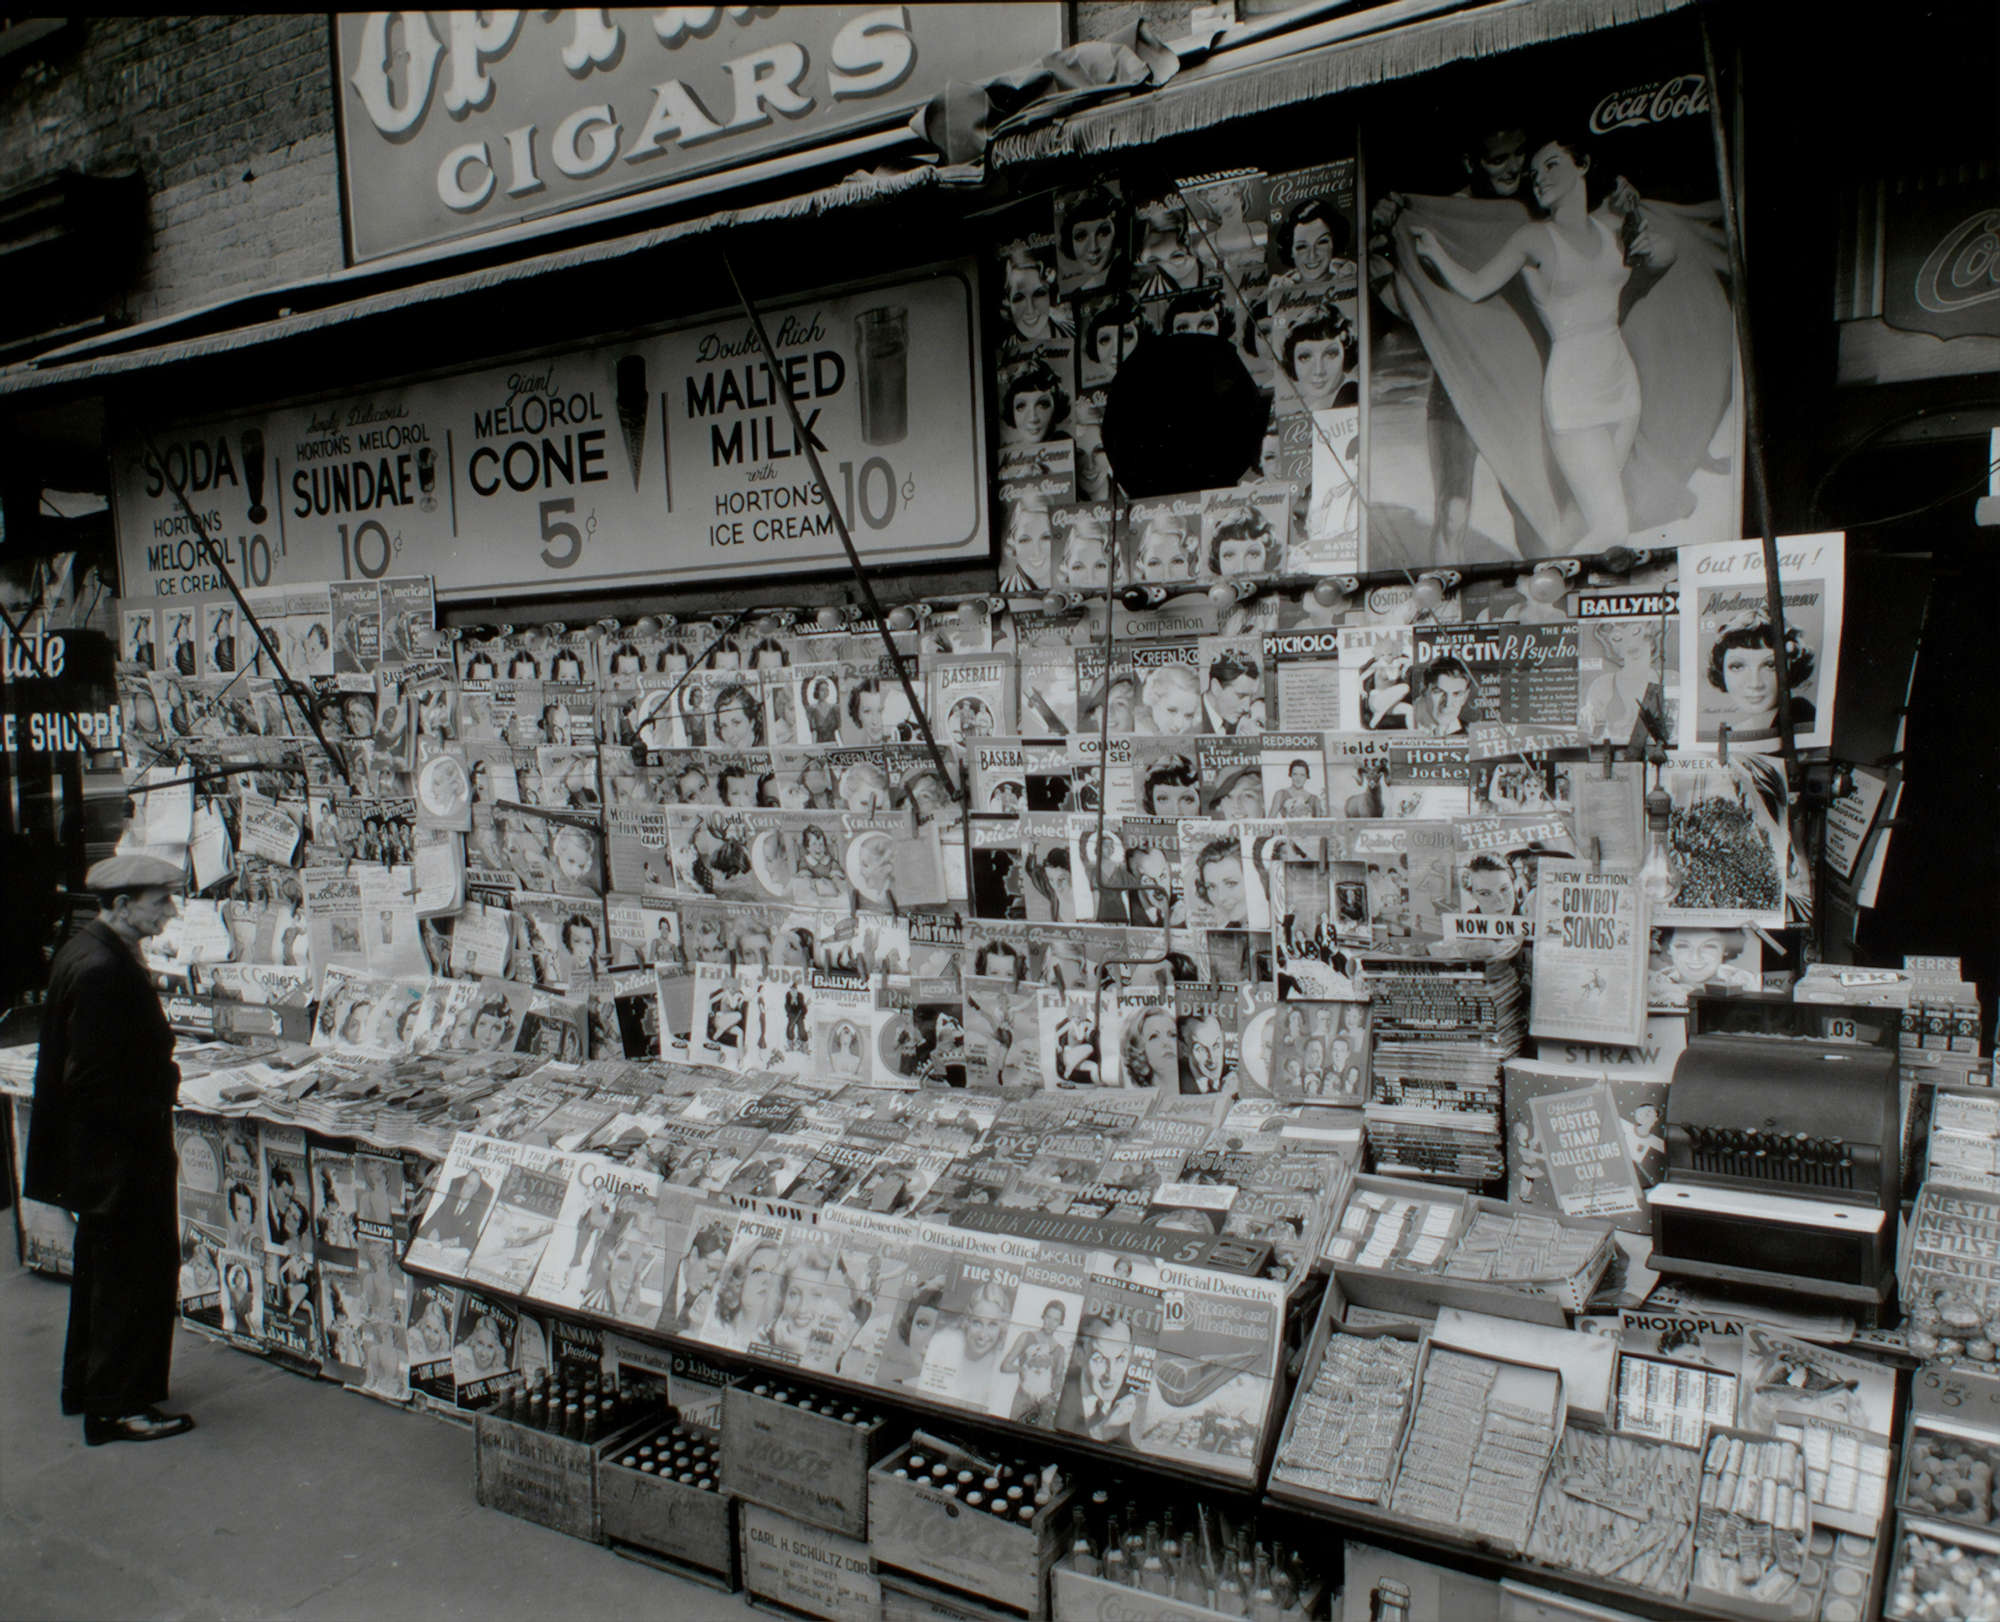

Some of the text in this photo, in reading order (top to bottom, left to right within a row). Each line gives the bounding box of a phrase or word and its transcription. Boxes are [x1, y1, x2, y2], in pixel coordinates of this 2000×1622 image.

[437, 7, 914, 211] CIGARS
[1589, 73, 1710, 135] Coca-Cola
[1175, 166, 1260, 189] BALLYHOO
[777, 312, 826, 348] Rich
[686, 351, 846, 418] MALTED
[474, 392, 603, 438] MELOROL
[296, 422, 431, 461] HORTON'S MELOROL
[711, 409, 829, 466] MILK
[145, 436, 239, 499] SODA
[469, 430, 608, 497] CONE
[745, 463, 778, 482] with
[292, 455, 415, 518] SUNDAE
[715, 479, 826, 516] HORTON'S
[1089, 506, 1124, 524] Stas
[709, 513, 835, 547] ICE CREAM
[147, 537, 236, 572] MELOROL
[1696, 545, 1824, 575] Out Toay!
[156, 579, 176, 596] ICE
[1126, 615, 1204, 636] Companion
[1133, 649, 1177, 666] SCREEN
[942, 665, 1000, 688] BASEBALL
[1262, 735, 1318, 747] REDBOOK
[1455, 815, 1501, 836] NEW
[1461, 821, 1567, 850] THEATRE
[1553, 872, 1629, 885] NEW EDITION
[1562, 886, 1620, 915] COWBOY
[1455, 918, 1516, 936] NOW ON
[1562, 915, 1616, 951] SONGS
[1904, 956, 1960, 970] KERR'S
[1564, 1045, 1662, 1065] STRAW
[1138, 1119, 1205, 1137] RAILROAD
[1550, 1110, 1601, 1133] POSTER
[1559, 1128, 1601, 1149] STAMP
[1551, 1142, 1621, 1168] COLLECTORS
[580, 1161, 650, 1196] Collier's
[1256, 1163, 1326, 1188] SPIDER
[1078, 1182, 1151, 1206] HORROR
[1235, 1197, 1312, 1219] SPIDER
[737, 1219, 784, 1241] PICTURE
[922, 1228, 967, 1250] Official
[1024, 1218, 1108, 1245] PHILLIES
[1110, 1230, 1166, 1253] CIGAR
[1024, 1266, 1083, 1289] REDBOOK
[1159, 1268, 1279, 1302] Official Detective
[1143, 1287, 1159, 1298] THE
[1164, 1303, 1183, 1321] 10
[1623, 1313, 1746, 1338] PHOTOPLAY
[750, 1527, 778, 1549] CARL
[792, 1540, 842, 1569] SCHULTZ
